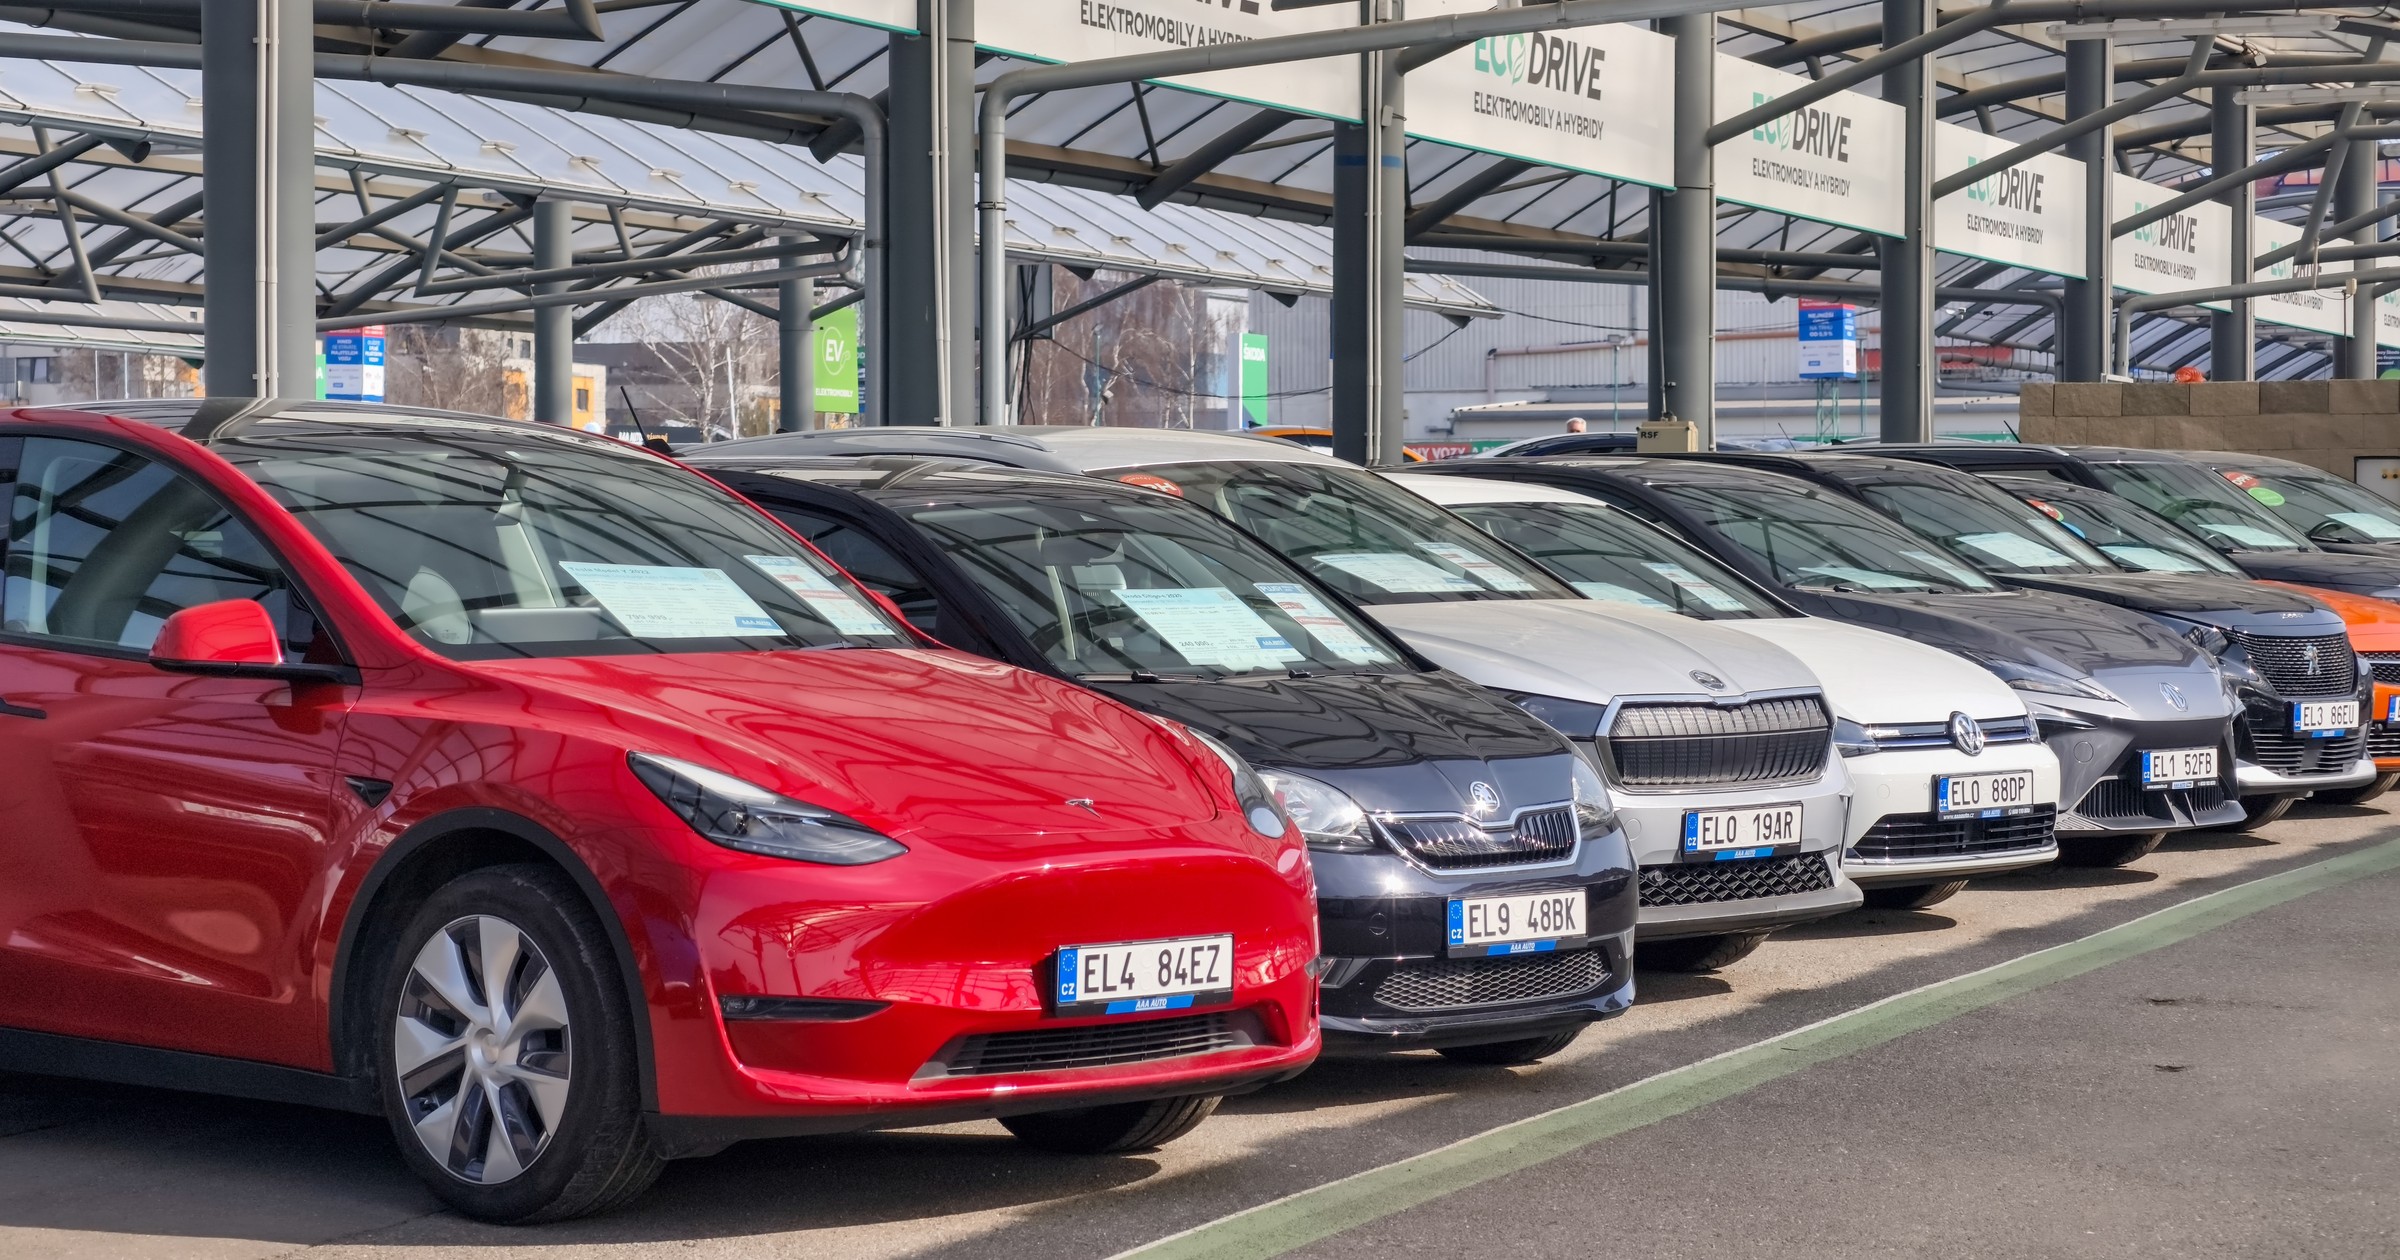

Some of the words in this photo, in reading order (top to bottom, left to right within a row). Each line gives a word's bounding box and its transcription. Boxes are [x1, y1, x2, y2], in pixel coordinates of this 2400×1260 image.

[1080, 1, 1195, 47] ELEKTROMOBILY
[1197, 26, 1206, 47] A
[1475, 33, 1526, 85] ECO
[1528, 32, 1606, 101] DRIVE
[1474, 91, 1554, 129] ELEKTROMOBILY
[1555, 111, 1563, 132] A
[1564, 112, 1604, 141] HYBRIDY
[1792, 107, 1851, 163] DRIVE
[1752, 157, 1813, 188] ELEKTROMOBILY
[1813, 172, 1820, 190] A
[1820, 173, 1850, 198] HYBRIDY
[1998, 167, 2044, 214] DRIVE
[1967, 213, 2015, 239] ELEKTROMOBILY
[2015, 225, 2020, 240] A
[2020, 225, 2043, 245] HYBRIDY
[2160, 213, 2197, 254] DRIVE
[2134, 253, 2173, 276] ELEKTROMOBILY
[2177, 263, 2197, 281] HYBRIDY
[825, 339, 845, 362] EV
[1640, 431, 1659, 439] RSF
[2303, 706, 2323, 726] EL3
[2331, 705, 2355, 725] 86EU
[2154, 754, 2175, 778] EL1
[2184, 752, 2212, 776] 52FB
[1992, 777, 2025, 803] 88DP
[1752, 811, 1793, 842] 19AR
[1687, 837, 1697, 847] CZ
[1469, 903, 1511, 938] EL9
[1527, 897, 1576, 933] 48BK
[1451, 928, 1463, 940] CZ
[1511, 943, 1522, 952] AAA
[1522, 942, 1536, 951] AUTO
[1084, 951, 1136, 994] EL4
[1157, 944, 1221, 987] 84EZ
[1061, 982, 1075, 996] CZ
[1136, 1000, 1150, 1010] AAA
[1150, 998, 1168, 1009] AUTO
